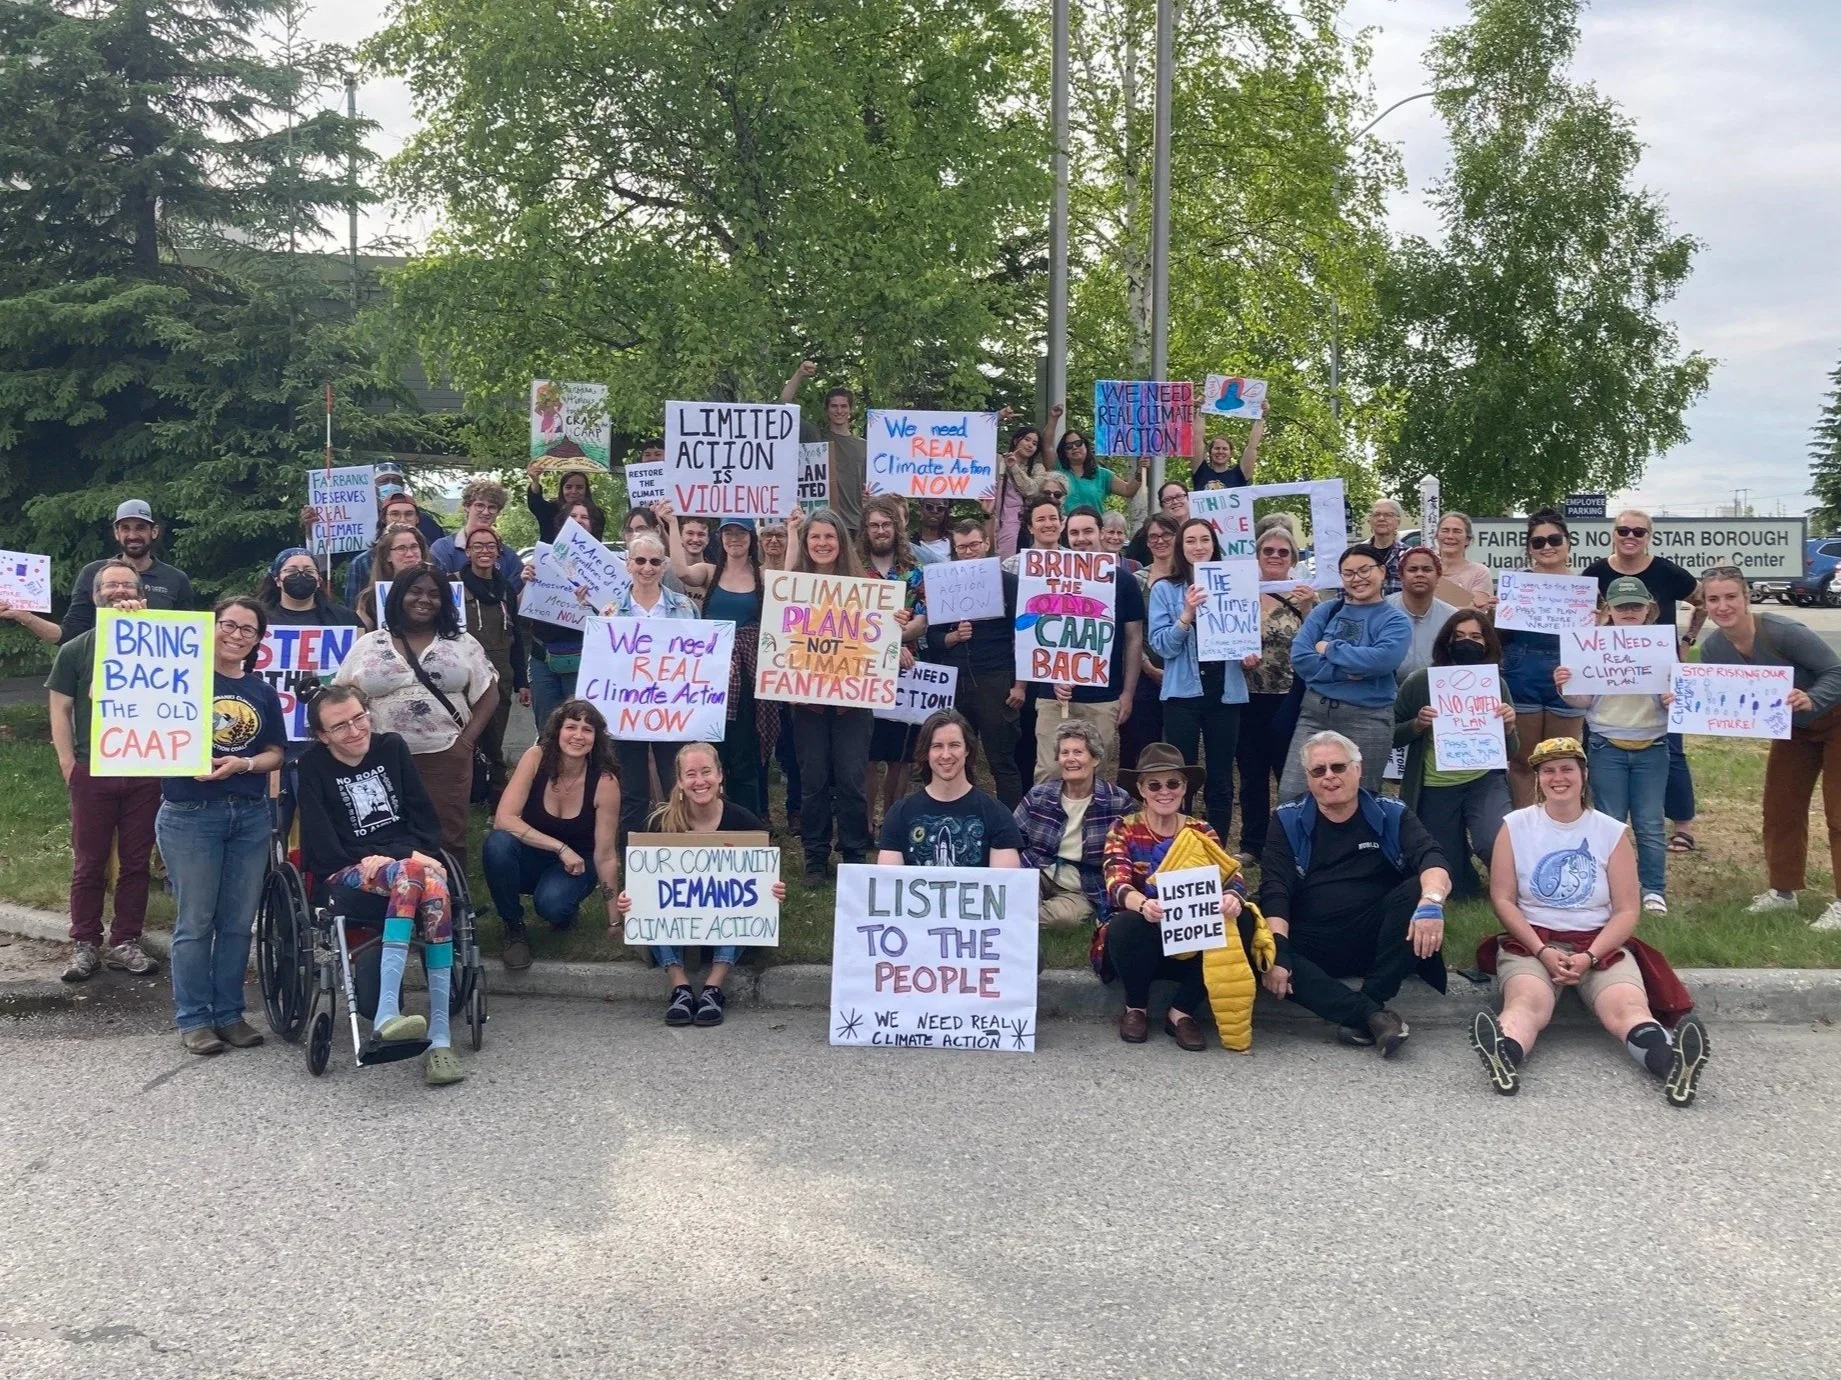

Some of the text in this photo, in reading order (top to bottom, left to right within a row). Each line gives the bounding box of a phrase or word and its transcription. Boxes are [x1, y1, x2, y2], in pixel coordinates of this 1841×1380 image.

[1101, 384, 1140, 403] WE
[1147, 384, 1192, 402] NEED
[679, 408, 793, 440] LIMITED
[1098, 405, 1134, 426] REAL
[1137, 404, 1194, 426] CLIMATE
[884, 416, 968, 438] We need
[911, 436, 974, 460] REAL
[1113, 427, 1178, 453] ACTION
[675, 440, 774, 470] ACTION
[873, 452, 991, 476] Climate Action
[312, 472, 369, 489] FARBANKS
[628, 468, 664, 478] RESTORE
[712, 469, 733, 485] IS
[798, 464, 827, 482] AN
[631, 489, 665, 499] CLIMATE
[911, 475, 971, 496] NOW
[314, 490, 366, 504] DESERVES
[675, 484, 780, 515] VIOLENCE
[1192, 494, 1241, 513] THIS
[1566, 498, 1605, 506] EMPLOYEE
[315, 505, 352, 521] REAL
[1568, 507, 1603, 515] PARKING
[315, 523, 364, 538] CLIMATE
[1211, 516, 1249, 535] ACE
[1652, 531, 1695, 547] STAR
[1701, 530, 1789, 547] BOROUGH
[1025, 550, 1115, 584] BRING
[1566, 552, 1600, 568] elms
[1731, 552, 1785, 567] Center
[603, 564, 617, 580] On
[927, 563, 989, 580] CLIMATE
[1199, 567, 1231, 592] THE
[772, 575, 896, 611] CLIMATE
[940, 580, 985, 593] ACTION
[1046, 578, 1082, 594] THE
[941, 590, 992, 614] NOW
[1036, 596, 1096, 615] OLD
[1213, 592, 1249, 612] TIME
[556, 609, 585, 624] NOW
[782, 605, 882, 643] PLANS
[115, 619, 199, 658] BRING
[607, 622, 719, 657] We need
[1035, 614, 1115, 656] CAAP
[1572, 629, 1669, 651] WE NEED a
[252, 629, 354, 670] STEN
[806, 637, 844, 655] NOT
[772, 653, 878, 677] CLIMATE
[1032, 648, 1108, 684] BACK
[1603, 652, 1636, 664] REAL
[102, 659, 189, 694] BACK
[632, 656, 710, 684] REAL
[898, 667, 949, 684] E NEED
[1582, 665, 1652, 678] CLIMATE
[1682, 665, 1714, 677] STOP
[1716, 667, 1760, 679] RISKING
[586, 678, 726, 706] Climate Action
[760, 670, 895, 704] FANTASIES
[896, 689, 953, 709] CTION!
[1438, 694, 1463, 714] NO
[97, 699, 198, 721] THE OLD
[619, 708, 695, 733] NOW
[1452, 716, 1487, 728] PLAN
[100, 726, 192, 760] CAAP
[1396, 746, 1405, 776] STORE
[336, 765, 385, 785] NO ROAD
[353, 828, 367, 837] TO
[628, 847, 779, 874] OUR COMMUNITY
[658, 875, 759, 909] DEMANDS
[868, 877, 1007, 920] LISTEN
[1162, 880, 1216, 901] LISTEN
[1164, 901, 1220, 922] TO THE
[625, 915, 777, 941] CLIMATE ACTION
[1164, 922, 1223, 944] PEOPLE
[857, 924, 1001, 960] TO THE
[875, 961, 1000, 998] PEOPLE
[874, 1011, 1012, 1030] WE NEED REAL
[872, 1032, 1001, 1049] CLIMATE ACTION
